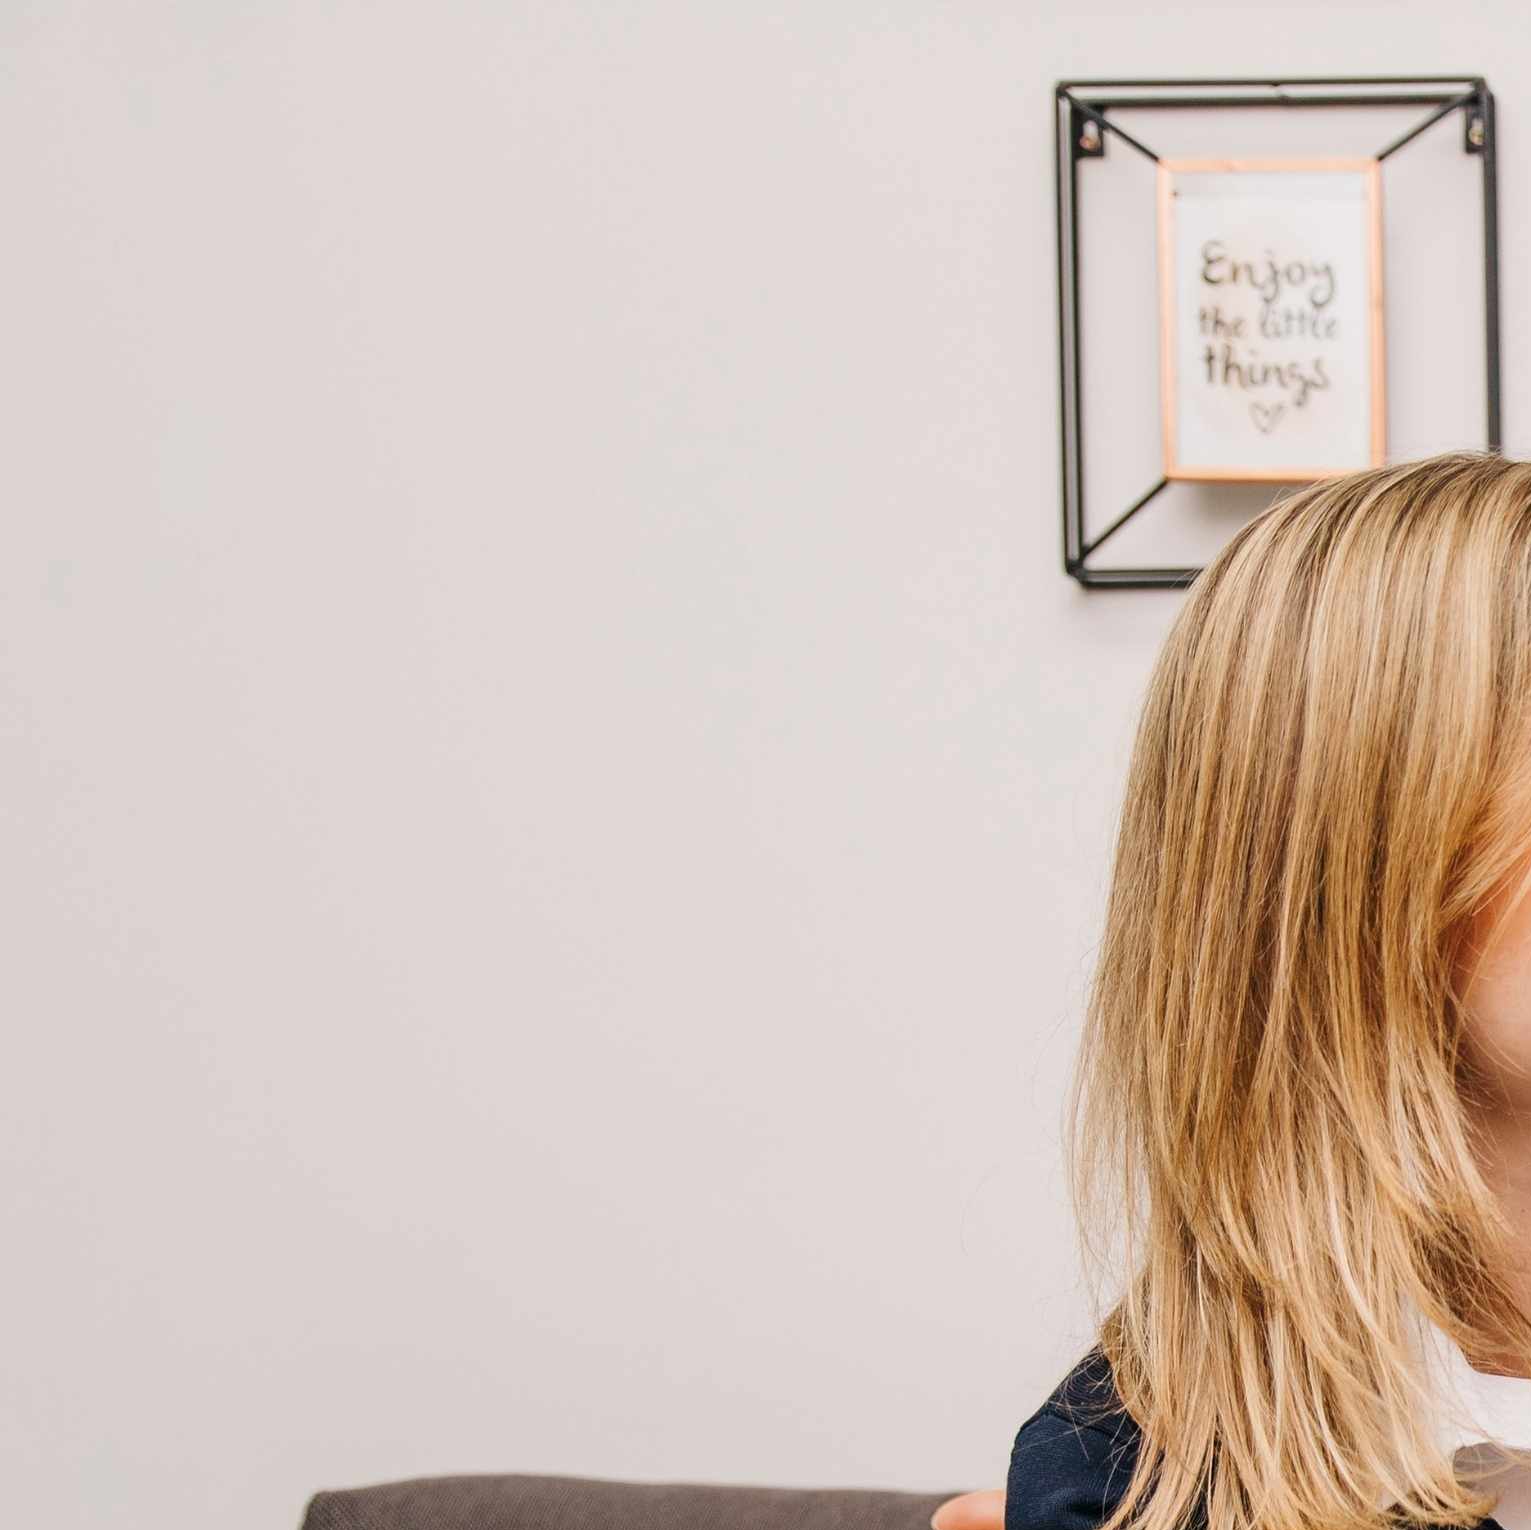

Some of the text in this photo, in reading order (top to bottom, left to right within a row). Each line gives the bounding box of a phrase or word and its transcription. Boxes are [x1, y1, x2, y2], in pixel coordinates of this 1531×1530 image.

[1200, 240, 1336, 308] Enjoy
[1199, 303, 1337, 341] the little
[1203, 343, 1329, 407] things
